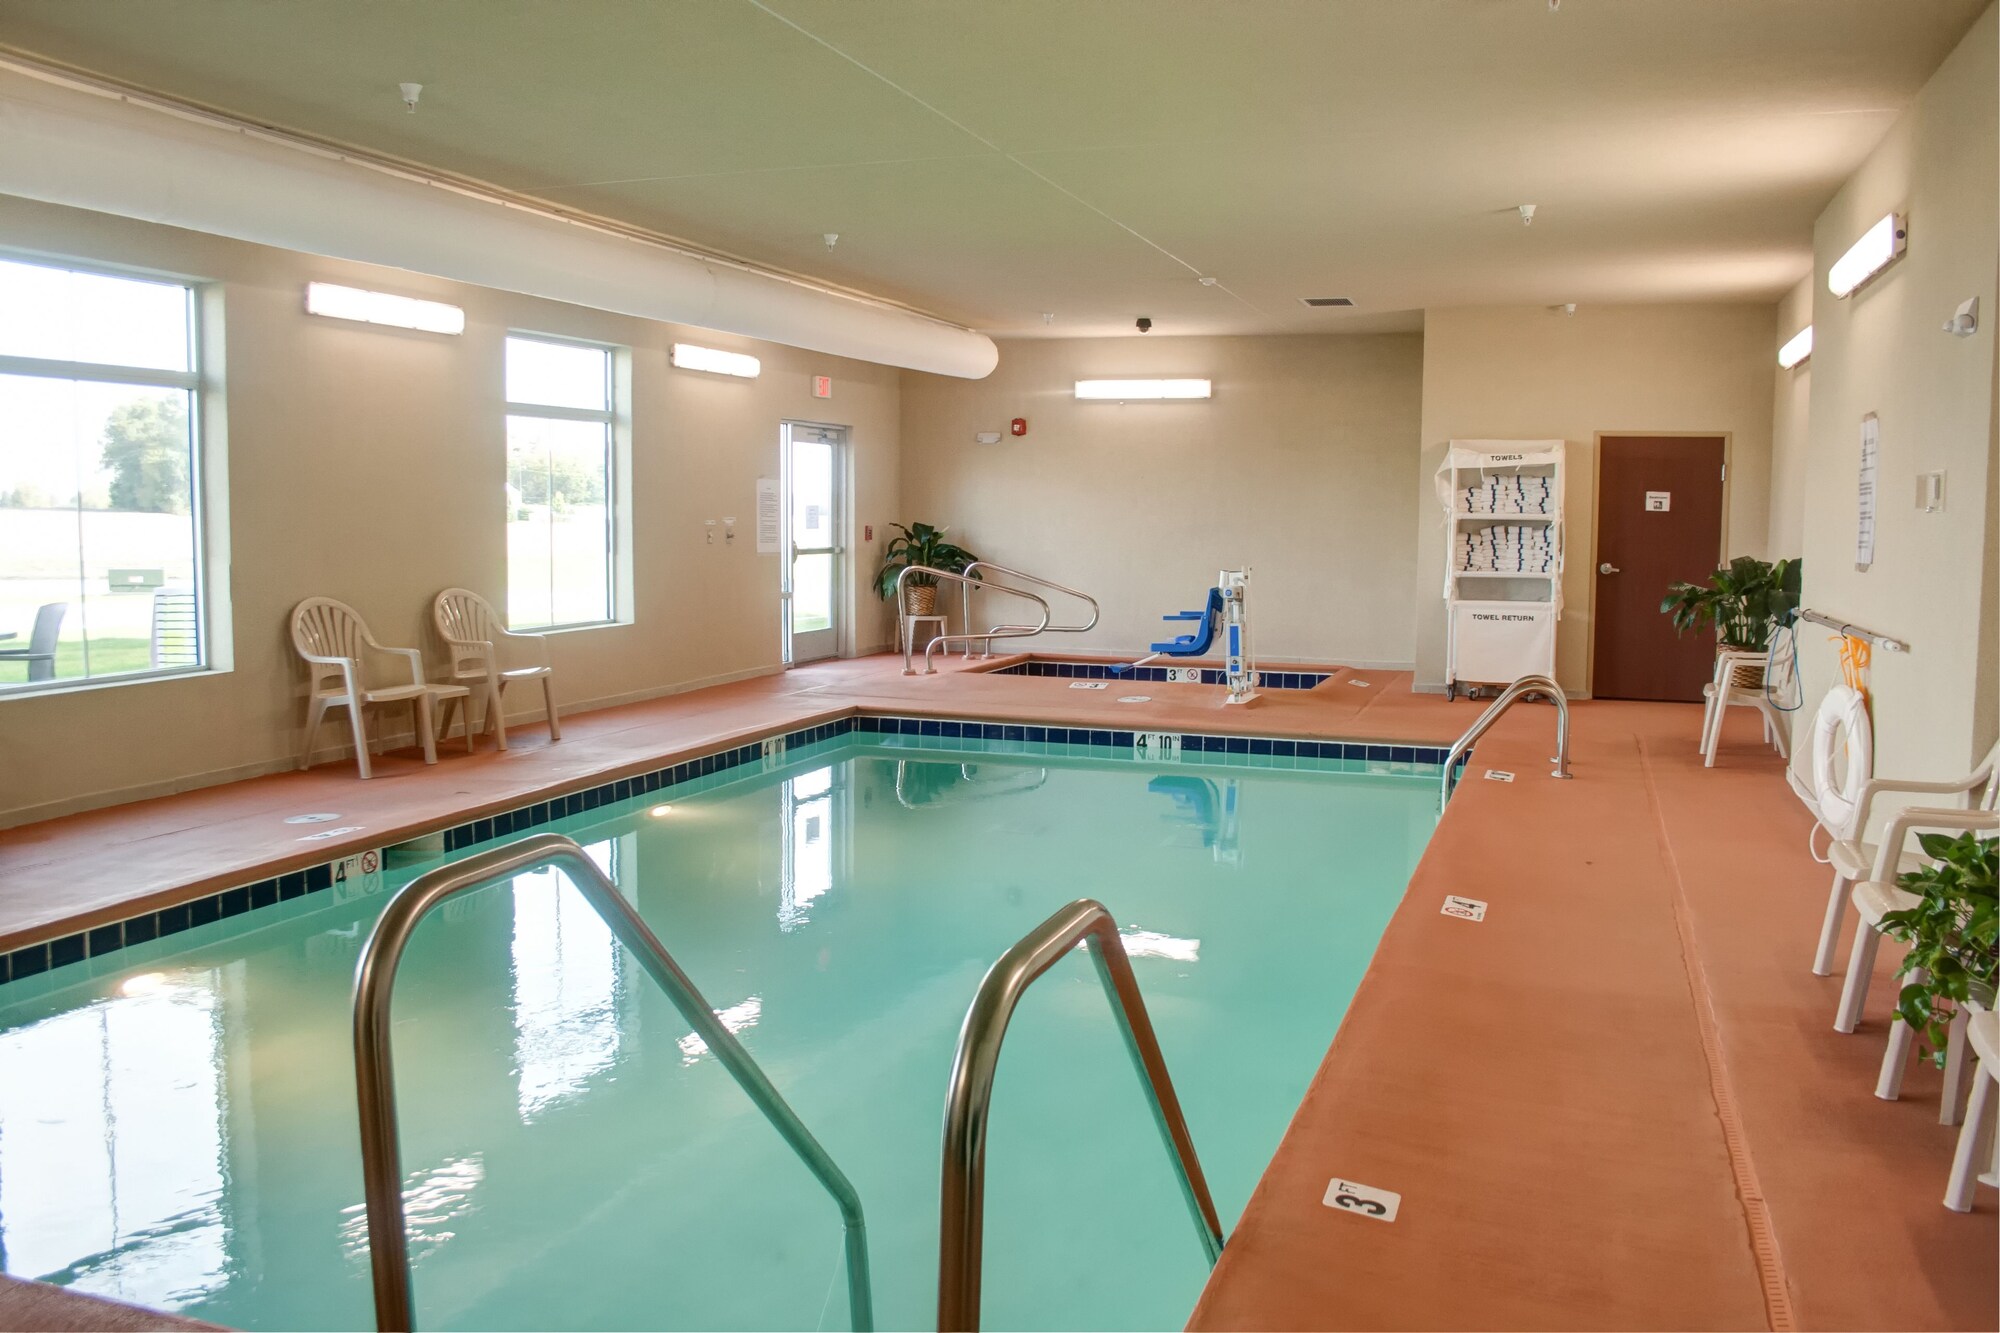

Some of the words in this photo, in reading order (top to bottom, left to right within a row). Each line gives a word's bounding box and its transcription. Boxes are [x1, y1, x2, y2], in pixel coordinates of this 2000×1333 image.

[1490, 454, 1523, 462] TOWELS
[1472, 614, 1500, 622] TOWEL
[1502, 614, 1535, 622] RETURN
[1169, 669, 1176, 681] 3
[1136, 733, 1148, 748] 4
[1158, 735, 1172, 749] 10
[335, 861, 347, 883] 4
[1338, 1182, 1357, 1194] FT
[1335, 1194, 1386, 1216] 3
